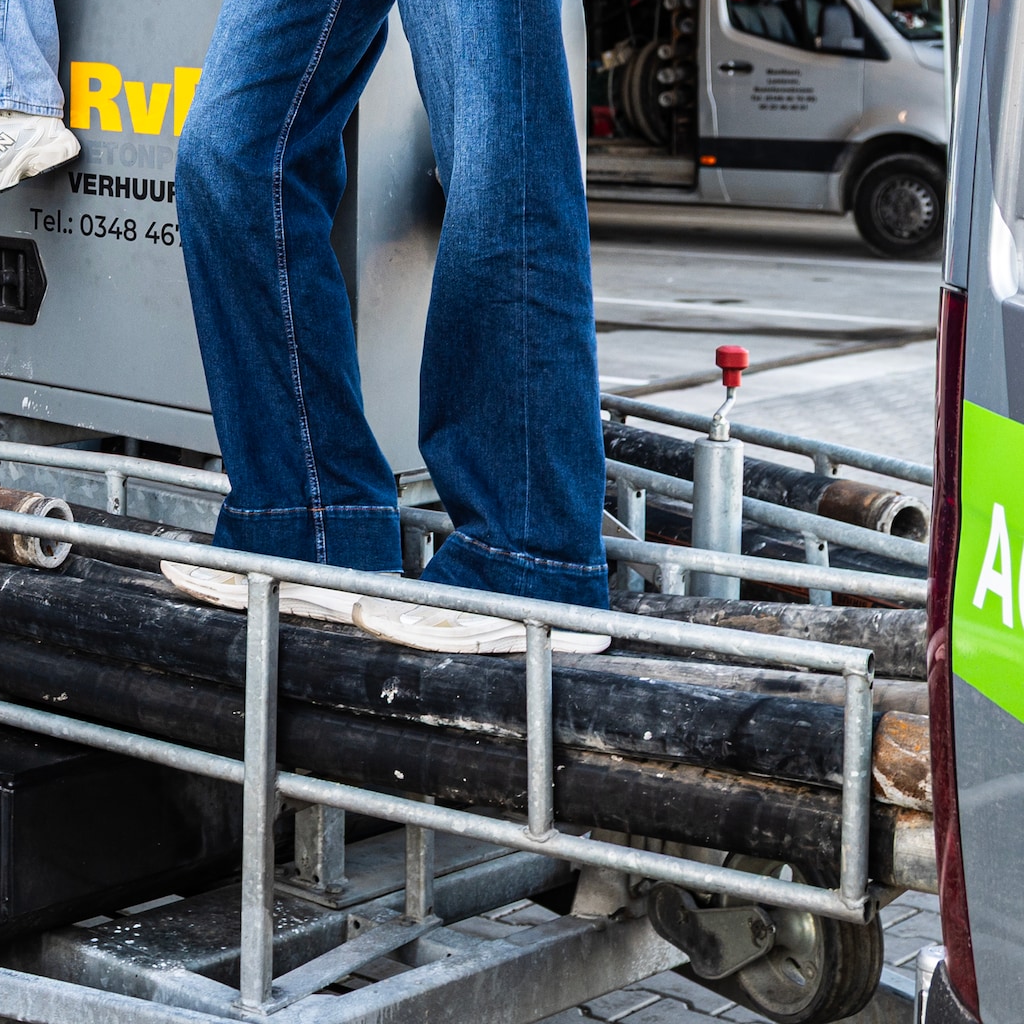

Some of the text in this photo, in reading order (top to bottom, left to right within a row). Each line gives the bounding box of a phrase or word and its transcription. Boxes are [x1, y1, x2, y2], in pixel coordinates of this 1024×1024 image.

[83, 140, 174, 170] ETONP
[30, 208, 73, 234] Tel.:
[80, 213, 137, 242] 0348
[972, 502, 1024, 633] A
